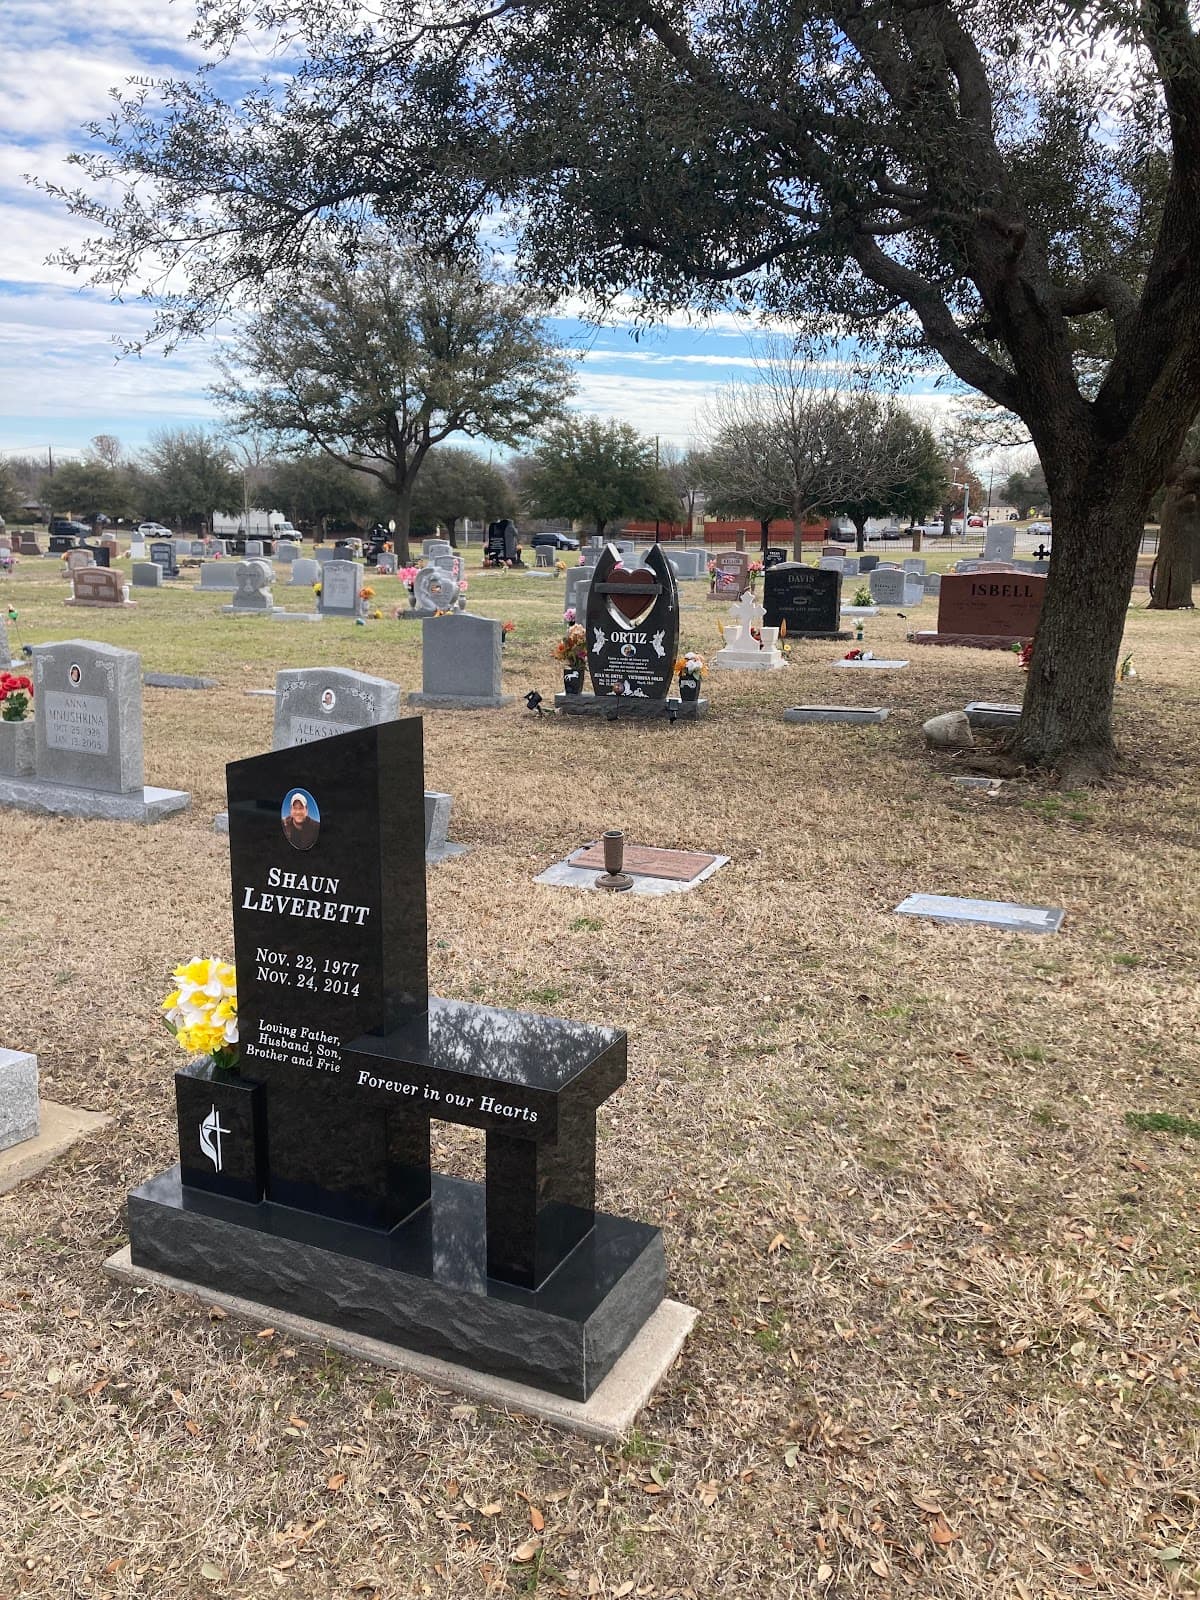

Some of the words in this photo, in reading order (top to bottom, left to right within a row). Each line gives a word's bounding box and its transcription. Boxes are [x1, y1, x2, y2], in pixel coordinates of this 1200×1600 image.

[788, 574, 815, 583] DAVIS
[971, 583, 1033, 597] ISBELL
[610, 631, 647, 644] ORTIZ
[64, 698, 88, 710] ANNA
[49, 708, 104, 727] MNUSHKINA
[297, 723, 346, 737] ALEKSAN
[267, 867, 340, 895] SHAUN
[241, 886, 370, 925] LEVERETT
[295, 954, 317, 973] 22,
[323, 959, 360, 977] 1977
[296, 973, 318, 992] 24,
[323, 978, 360, 997] 2014
[258, 1018, 297, 1039] Loving
[300, 1026, 341, 1047] Father,
[246, 1043, 289, 1062] Brother
[291, 1056, 313, 1068] and
[316, 1058, 341, 1073] Frie
[258, 1032, 313, 1055] Husband,
[316, 1044, 342, 1061] Son,
[356, 1070, 419, 1096] Forever
[423, 1084, 441, 1101] in
[445, 1093, 474, 1108] our
[479, 1095, 538, 1123] Hearts
